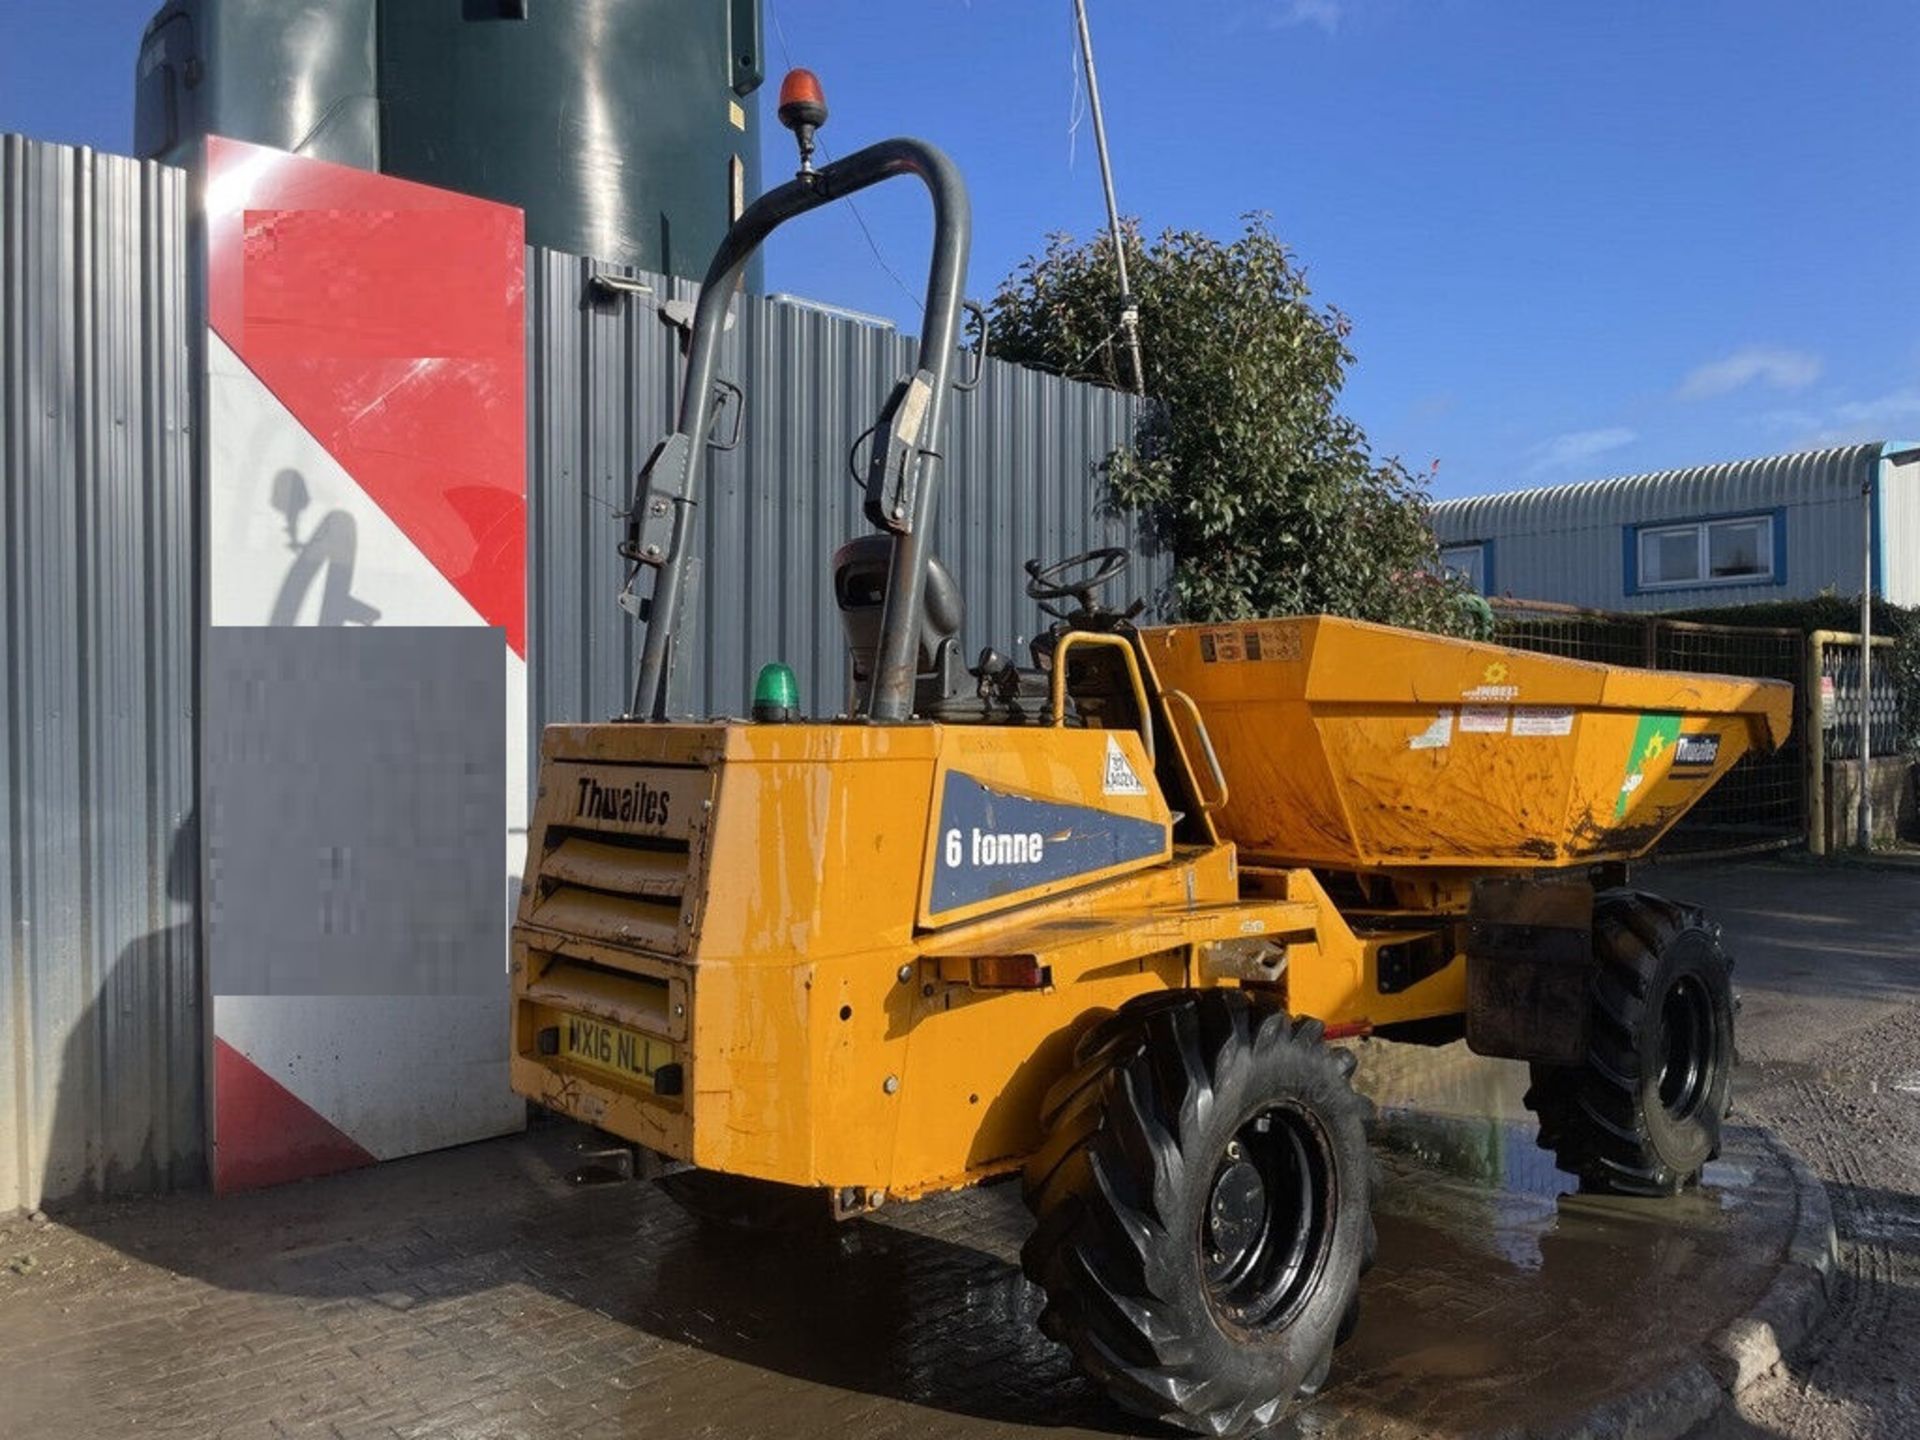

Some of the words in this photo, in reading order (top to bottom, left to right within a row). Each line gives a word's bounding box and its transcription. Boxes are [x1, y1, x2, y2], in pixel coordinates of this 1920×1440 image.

[576, 778, 670, 825] Thwaites
[946, 828, 962, 868] 6
[972, 827, 1043, 866] tonne
[616, 1032, 656, 1078] NLL
